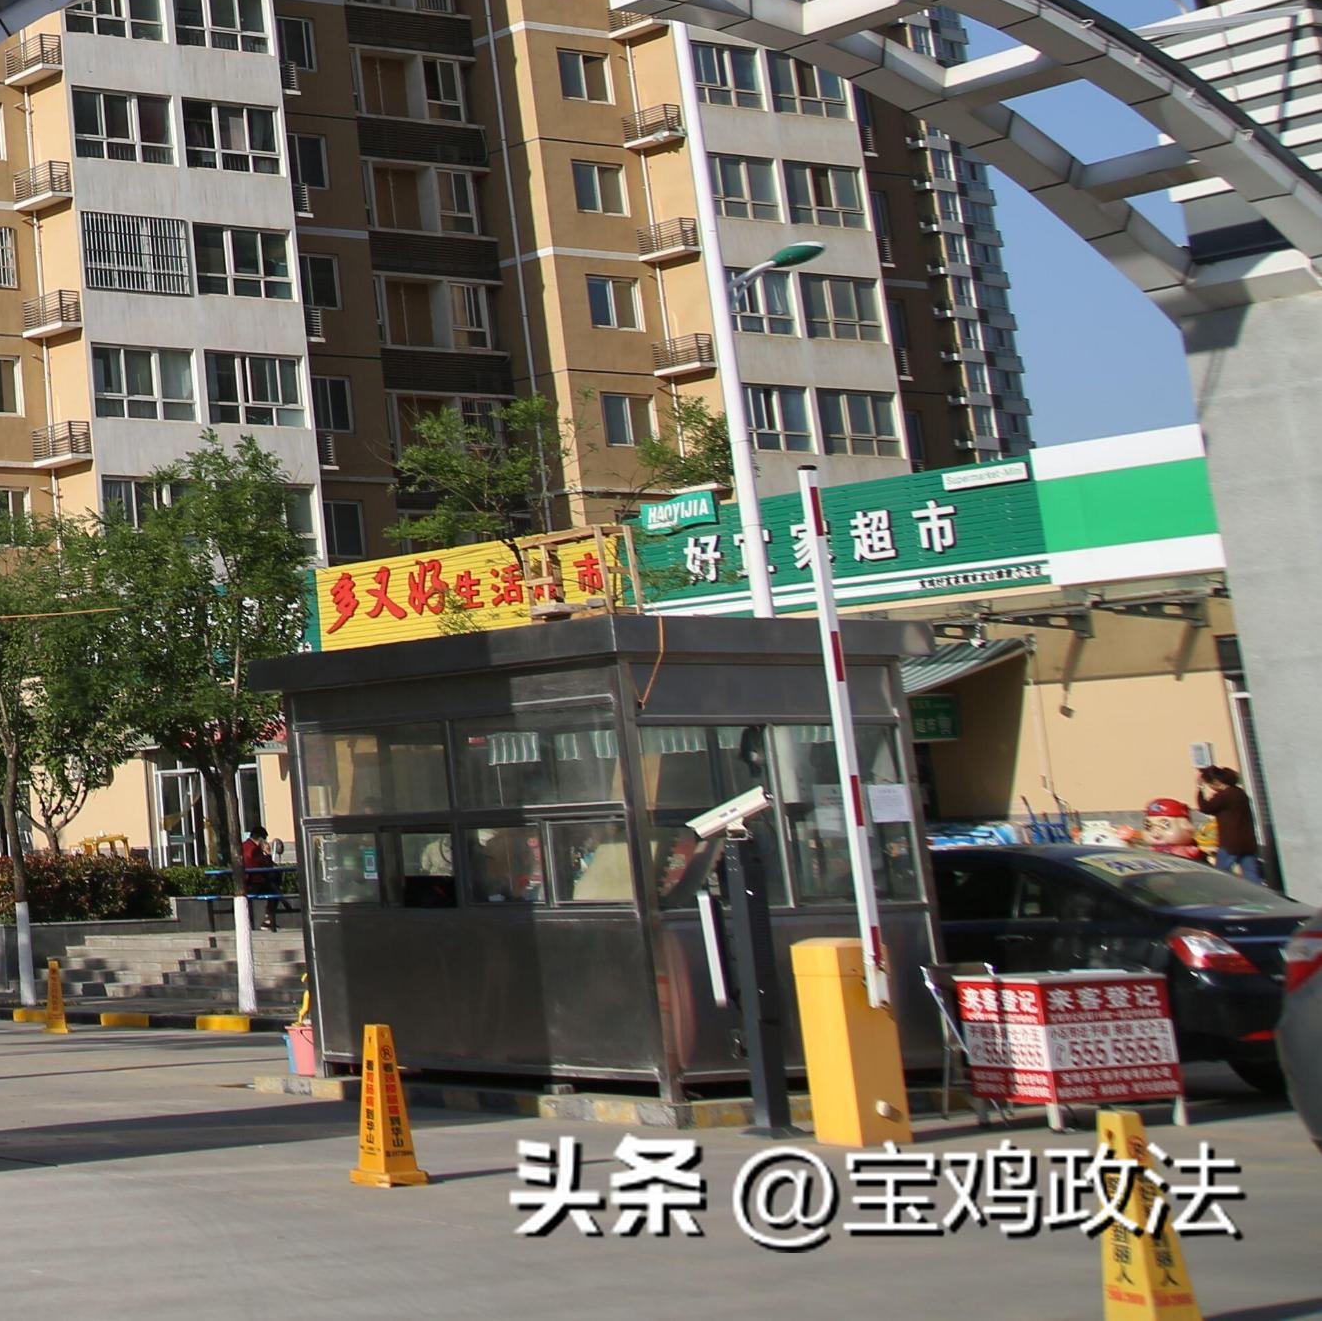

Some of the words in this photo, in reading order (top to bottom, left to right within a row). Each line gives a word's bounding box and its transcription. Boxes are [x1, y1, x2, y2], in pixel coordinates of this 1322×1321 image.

[647, 497, 710, 525] HAOYIJIA
[959, 987, 1039, 1012] 来客登记
[1047, 985, 1161, 1011] 来客登记
